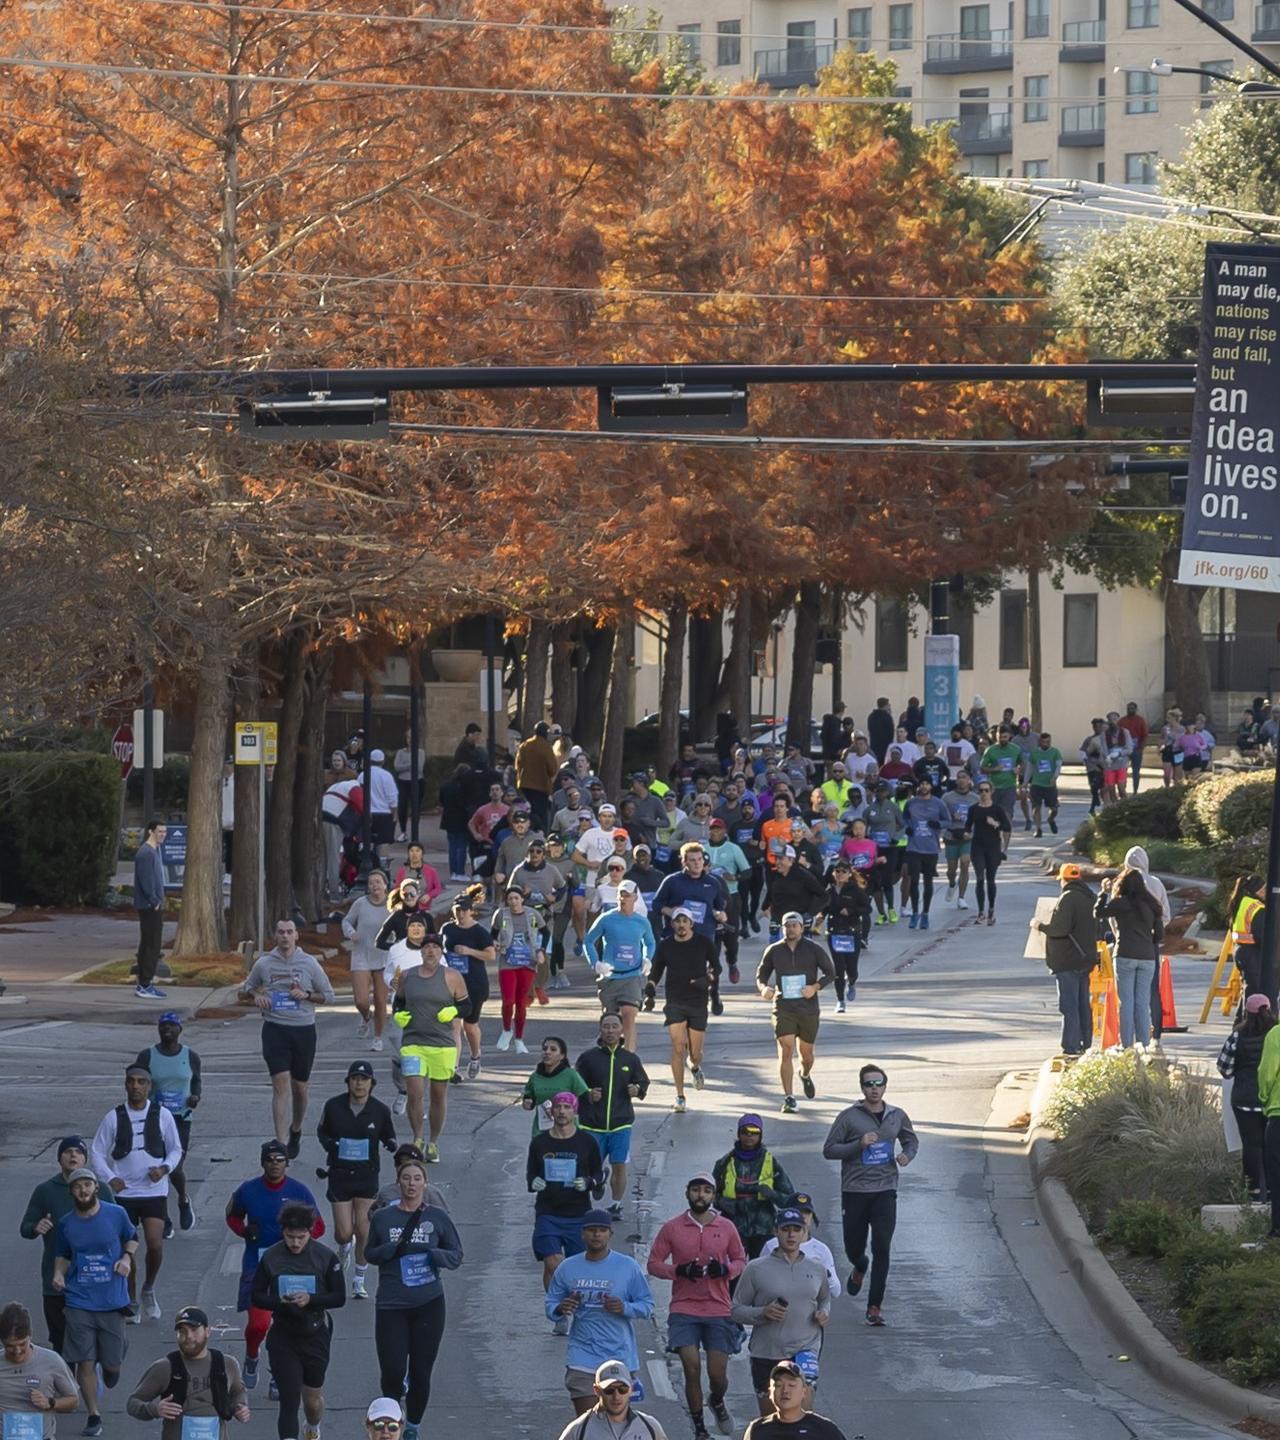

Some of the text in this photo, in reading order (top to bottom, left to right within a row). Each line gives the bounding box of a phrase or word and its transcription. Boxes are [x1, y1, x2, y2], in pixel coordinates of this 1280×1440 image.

[1219, 261, 1267, 277] A man
[1217, 284, 1280, 302] may die,
[1216, 304, 1270, 320] nations
[1214, 325, 1277, 342] may rise
[1212, 346, 1271, 366] and fall,
[1211, 366, 1235, 381] but
[1209, 386, 1248, 414] an
[1207, 417, 1274, 453] idea
[1204, 454, 1278, 491] lives
[1201, 491, 1248, 520] on.
[1194, 560, 1269, 580] jfk.org/60
